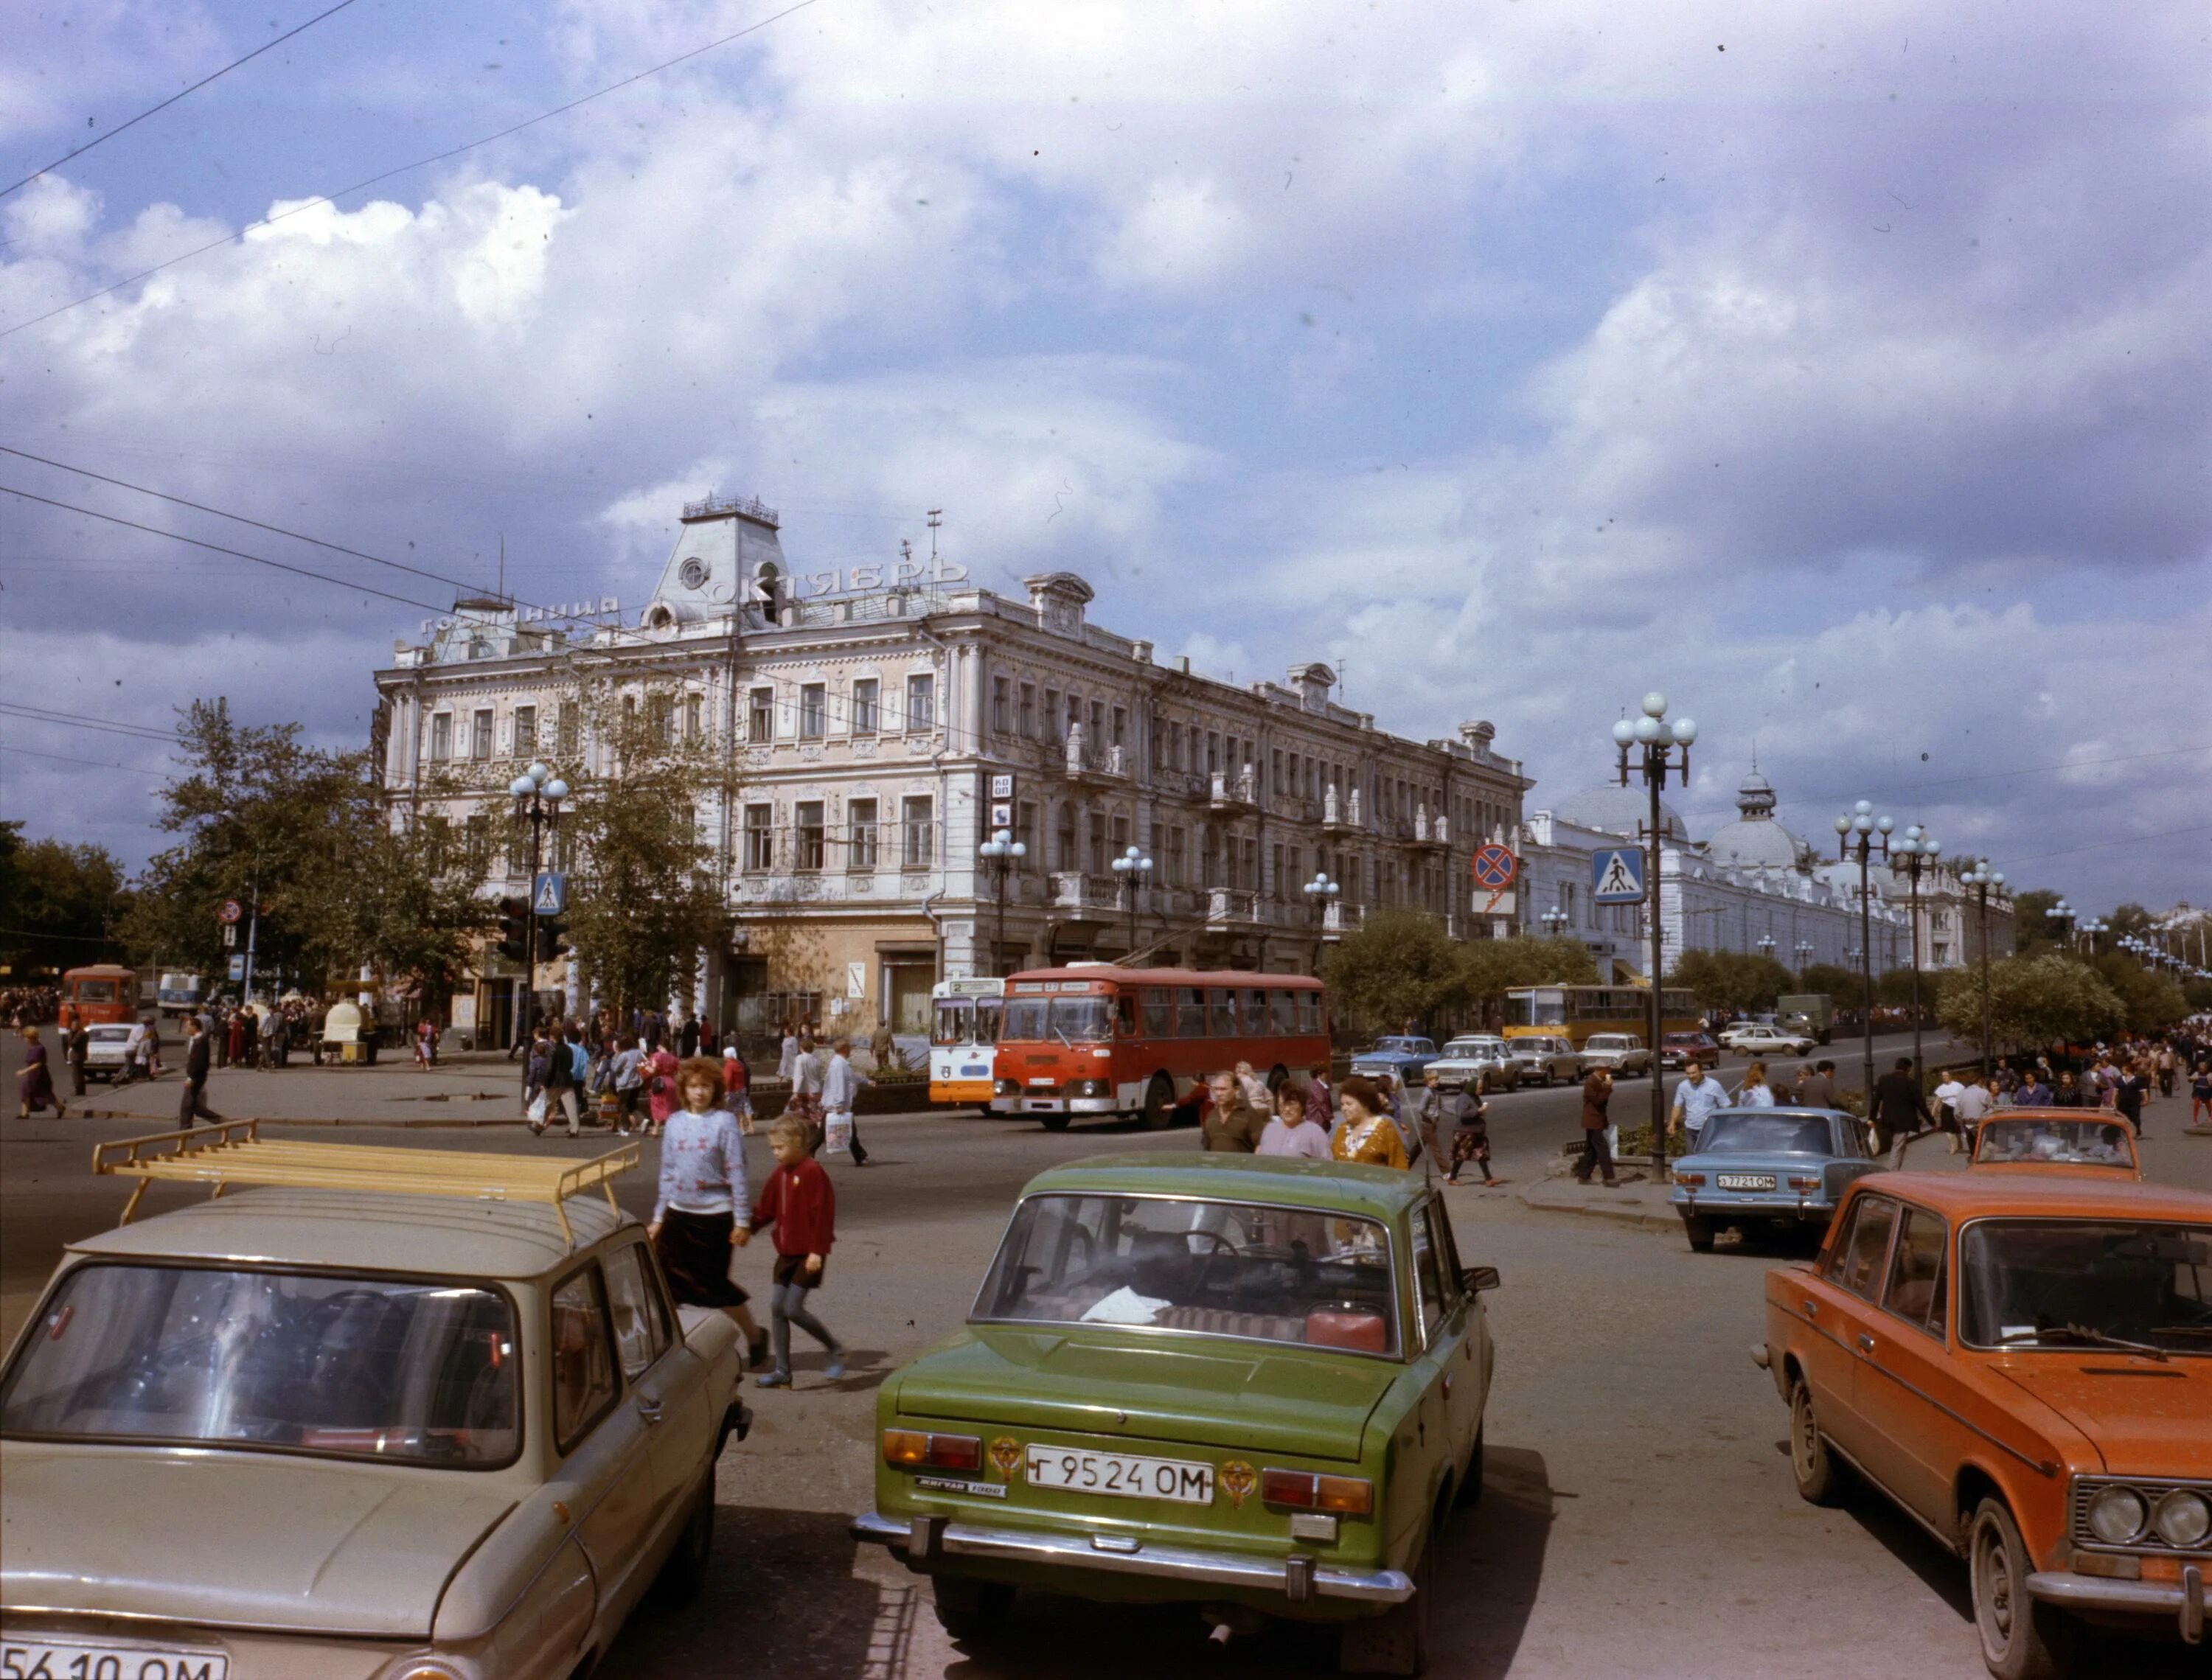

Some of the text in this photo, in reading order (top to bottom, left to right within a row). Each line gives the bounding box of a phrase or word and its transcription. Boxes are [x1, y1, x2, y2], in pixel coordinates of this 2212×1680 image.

[712, 558, 969, 604] ОКТЯБРЬ
[954, 984, 961, 992] 2
[1728, 1177, 1754, 1186] 7721
[1756, 1177, 1773, 1187] ОМ
[1061, 1455, 1142, 1492] 9524
[1156, 1465, 1206, 1500] ОМ
